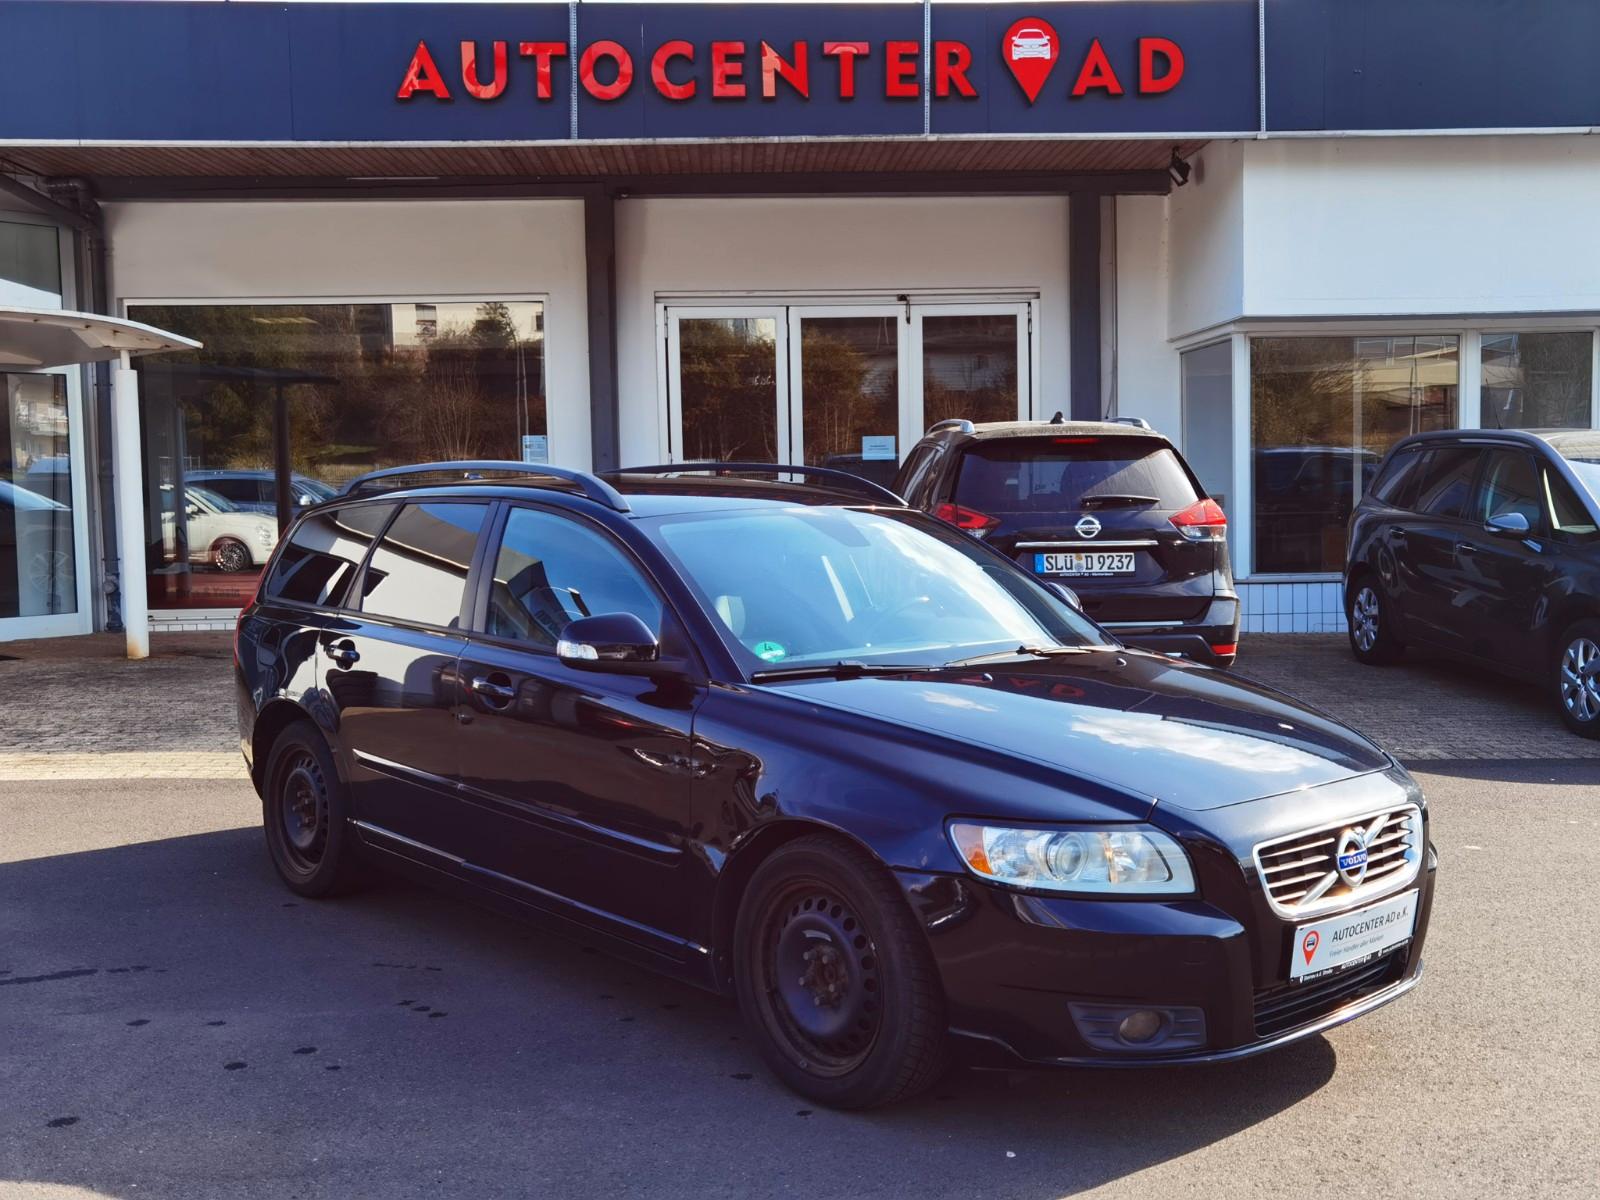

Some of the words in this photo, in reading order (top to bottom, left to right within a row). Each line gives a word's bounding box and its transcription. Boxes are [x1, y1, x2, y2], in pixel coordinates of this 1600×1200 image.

[395, 38, 978, 100] AUTOCENTER
[1071, 37, 1186, 97] AD
[1045, 555, 1073, 571] SLÜ
[1085, 554, 1094, 570] D
[1097, 554, 1133, 570] 9237
[1342, 853, 1367, 866] VOLVO
[1332, 916, 1385, 942] AUTOCENTER
[1385, 911, 1396, 925] AD
